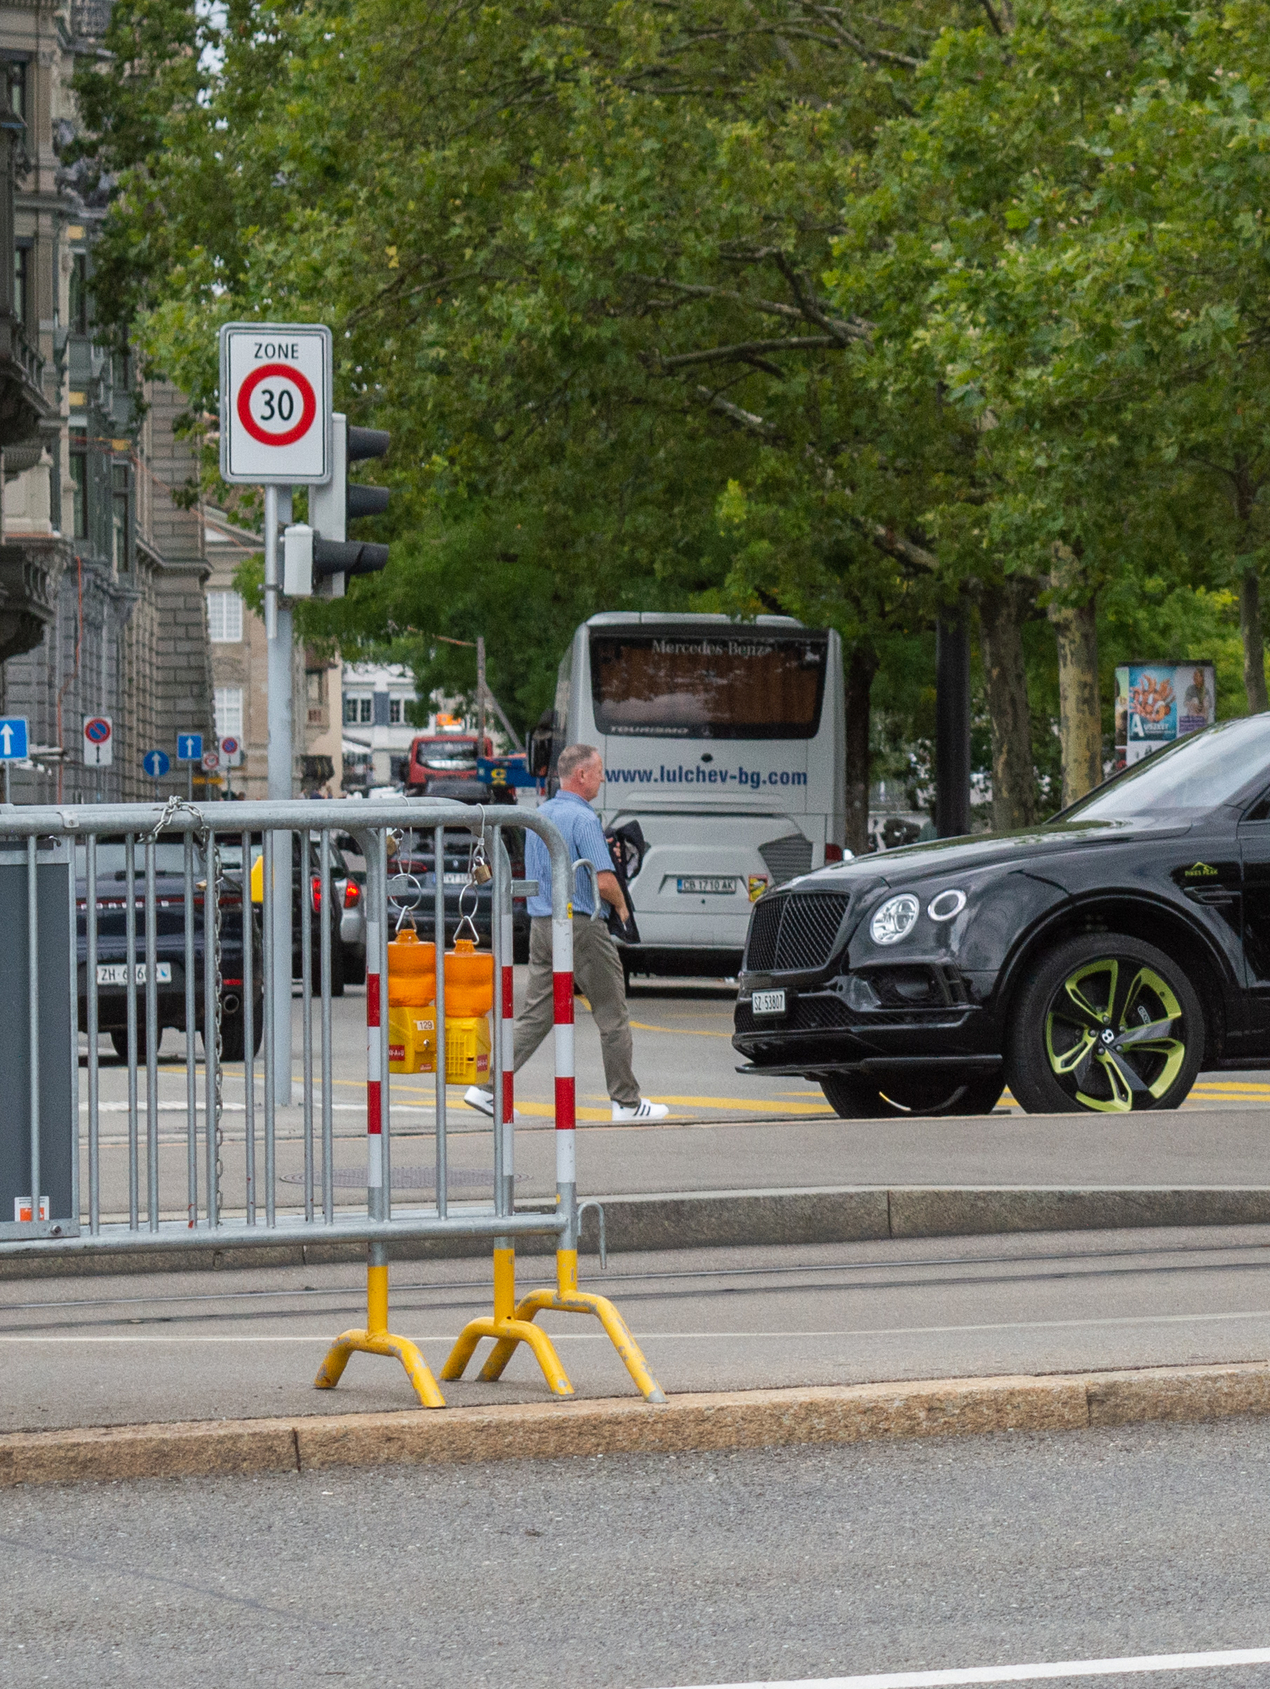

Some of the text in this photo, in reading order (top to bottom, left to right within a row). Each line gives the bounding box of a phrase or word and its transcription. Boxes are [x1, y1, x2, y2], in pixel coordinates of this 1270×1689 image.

[254, 343, 299, 359] ZONE
[260, 389, 294, 421] 30
[604, 765, 808, 789] www.lulchev-bg.com
[419, 1020, 433, 1030] 129
